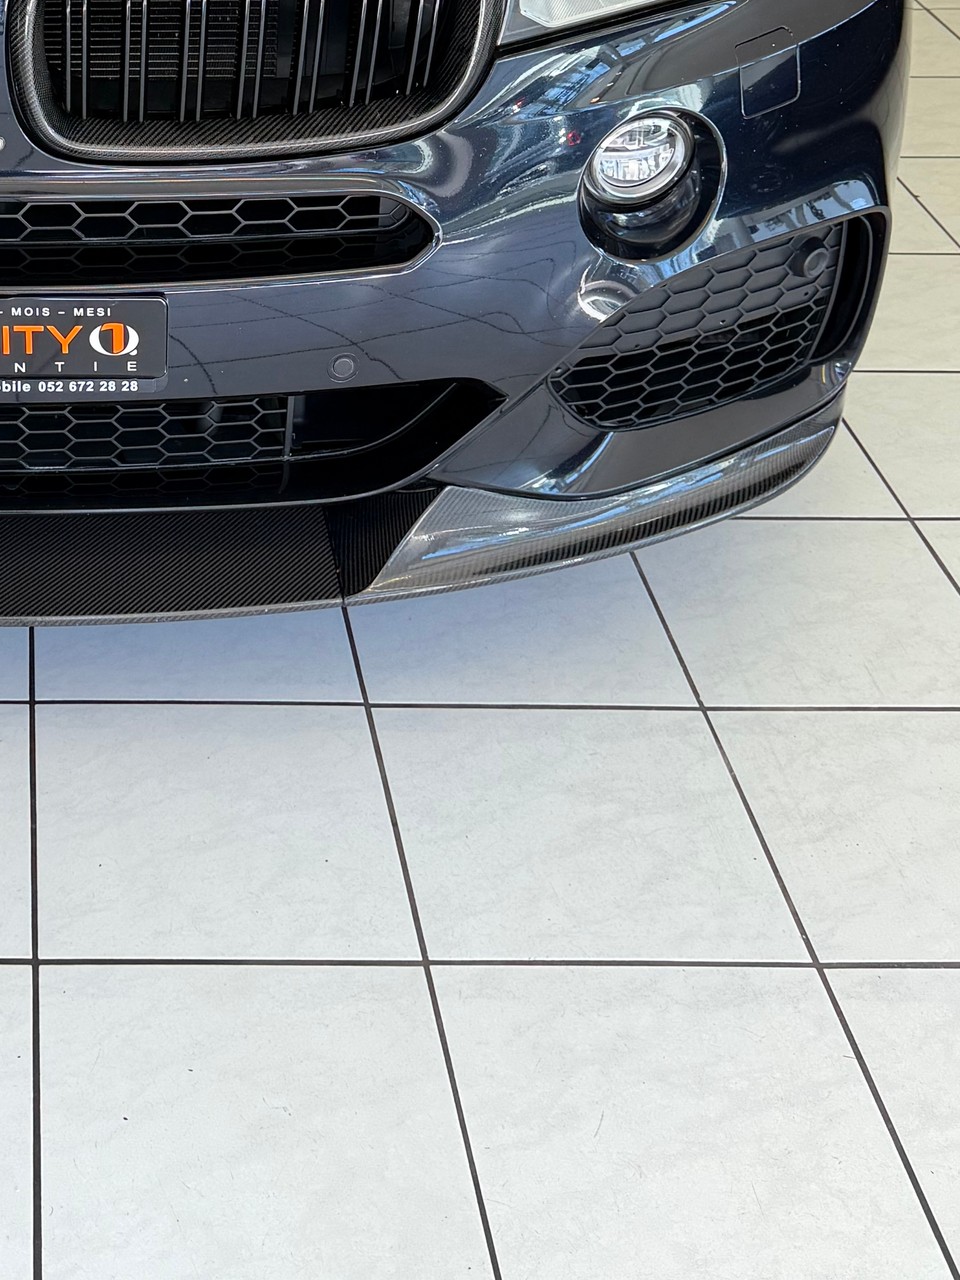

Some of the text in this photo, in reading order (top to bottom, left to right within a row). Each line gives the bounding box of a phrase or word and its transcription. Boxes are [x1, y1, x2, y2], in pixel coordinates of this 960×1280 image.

[11, 307, 50, 316] MOIS
[73, 307, 111, 317] MESI
[38, 381, 64, 392] 052
[68, 381, 94, 392] 672
[99, 380, 116, 392] 28
[121, 380, 138, 392] 28
